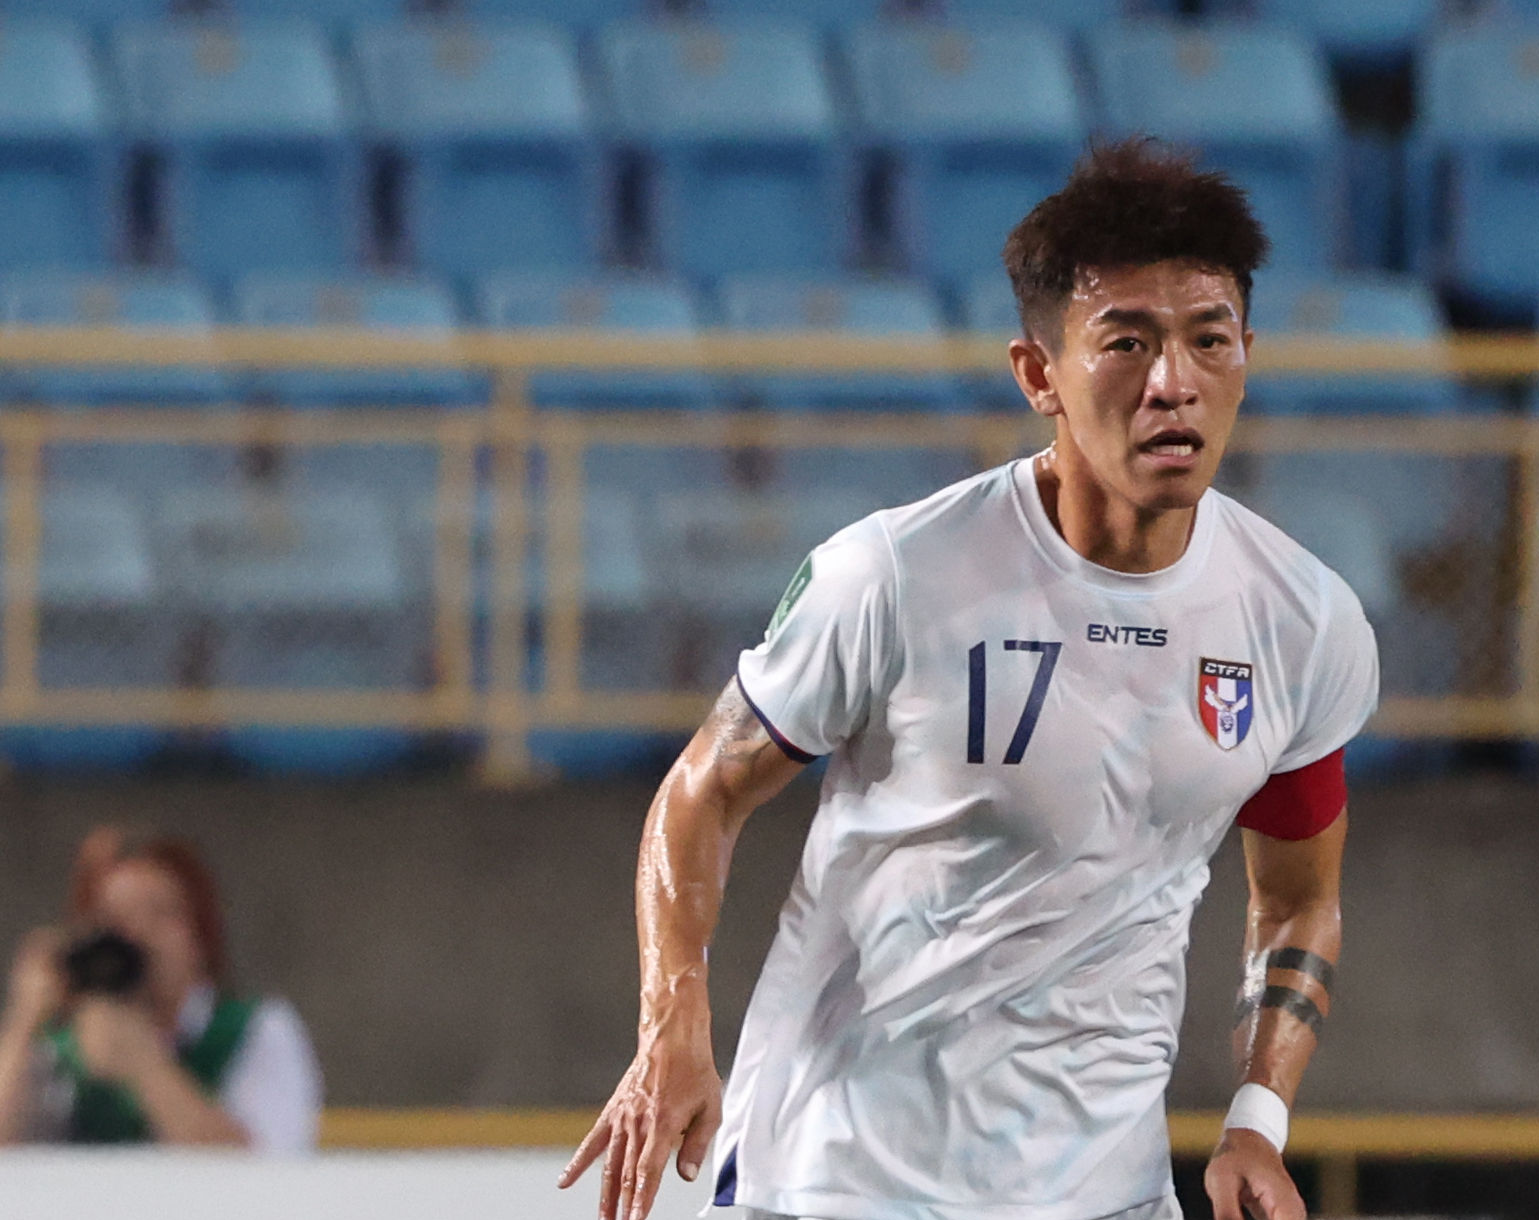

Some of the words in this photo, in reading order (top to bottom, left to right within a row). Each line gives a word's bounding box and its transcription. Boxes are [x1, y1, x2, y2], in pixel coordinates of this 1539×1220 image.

[1088, 624, 1168, 647] ENTES
[1204, 662, 1251, 679] CTFA
[967, 640, 1063, 764] 17
